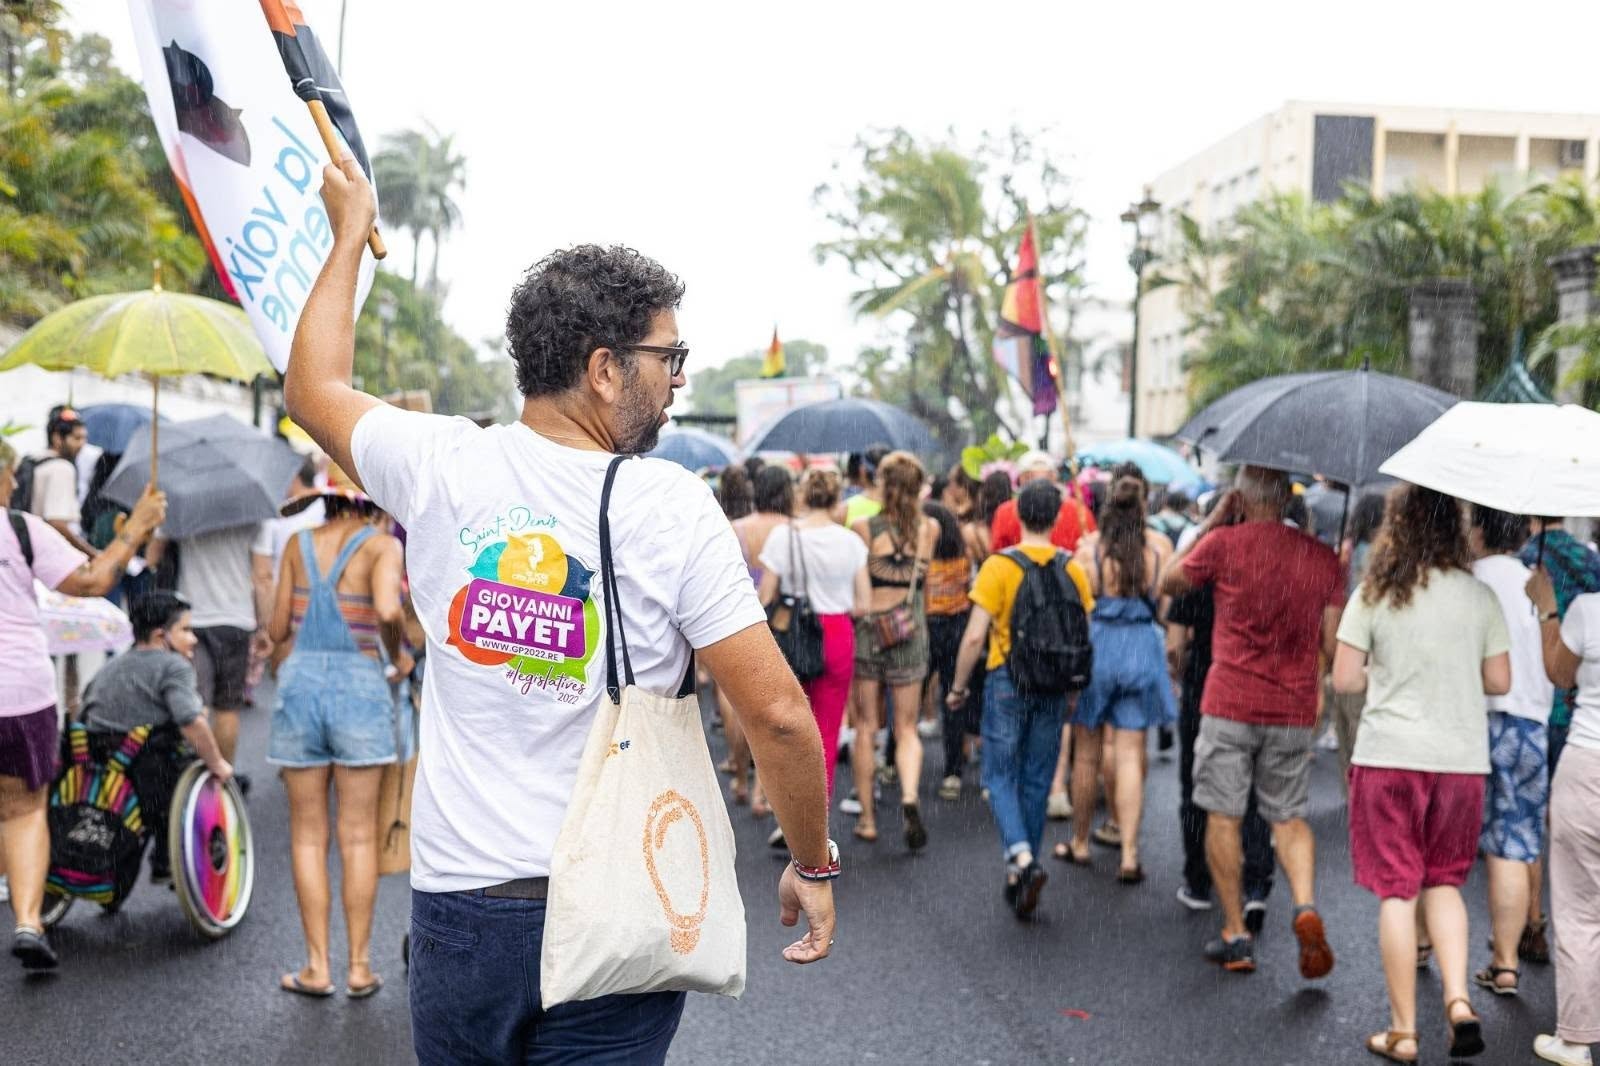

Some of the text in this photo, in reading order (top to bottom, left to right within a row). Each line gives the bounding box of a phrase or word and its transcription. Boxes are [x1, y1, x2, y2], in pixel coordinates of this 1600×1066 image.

[478, 588, 572, 621] GIOVANNI
[470, 605, 575, 648] PAYET
[481, 639, 559, 661] WWW.GP2022.RE
[557, 692, 579, 705] 2022
